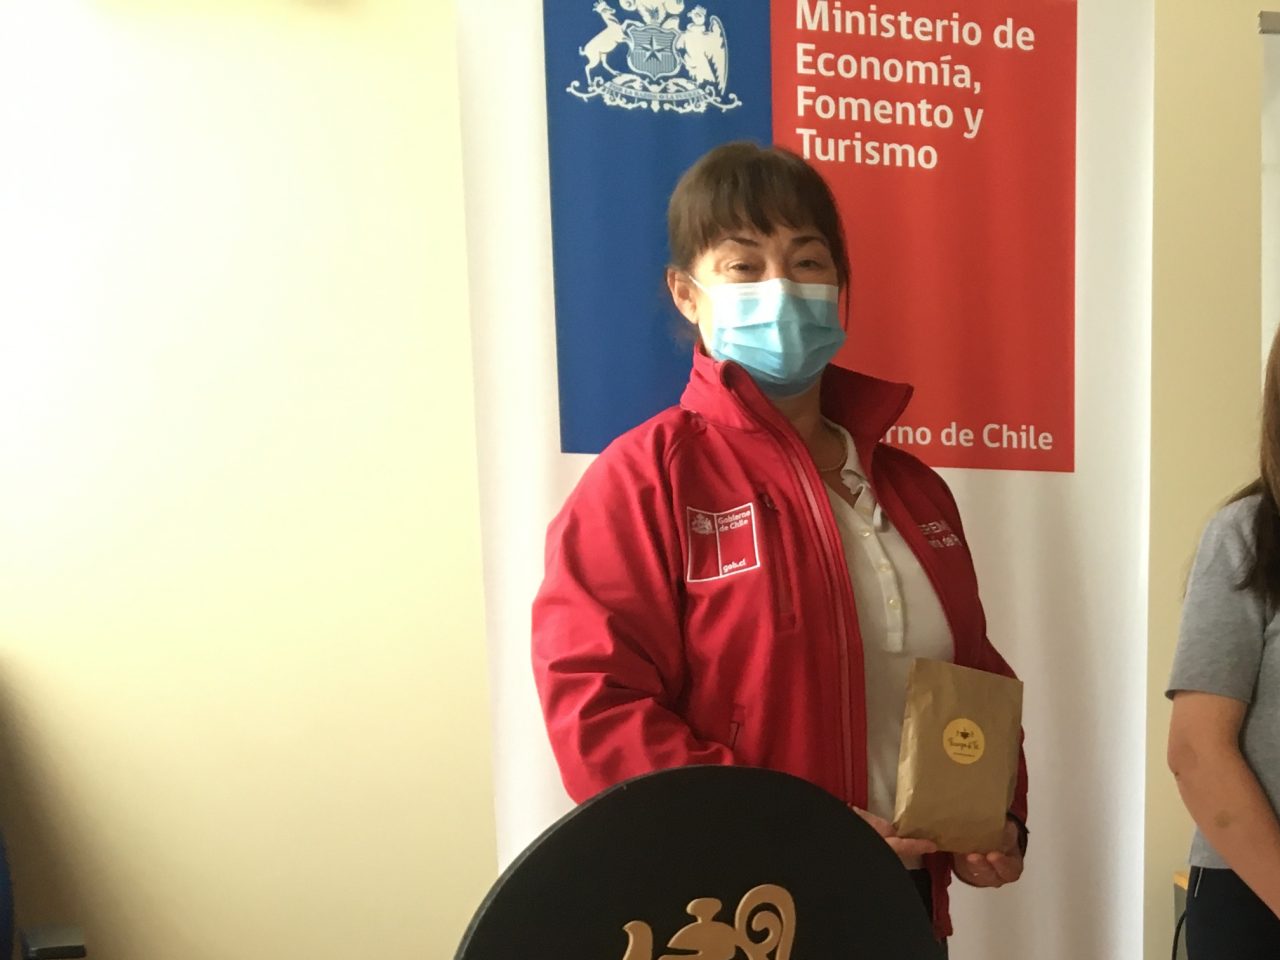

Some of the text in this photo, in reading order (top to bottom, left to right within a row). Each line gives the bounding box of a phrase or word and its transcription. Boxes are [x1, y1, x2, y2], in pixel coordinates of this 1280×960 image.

[795, 0, 1036, 51] Ministerio de
[796, 42, 982, 94] Economía,
[796, 85, 984, 139] Fomento y
[795, 128, 938, 170] Turismo
[940, 421, 974, 447] de
[982, 423, 1053, 450] Chile
